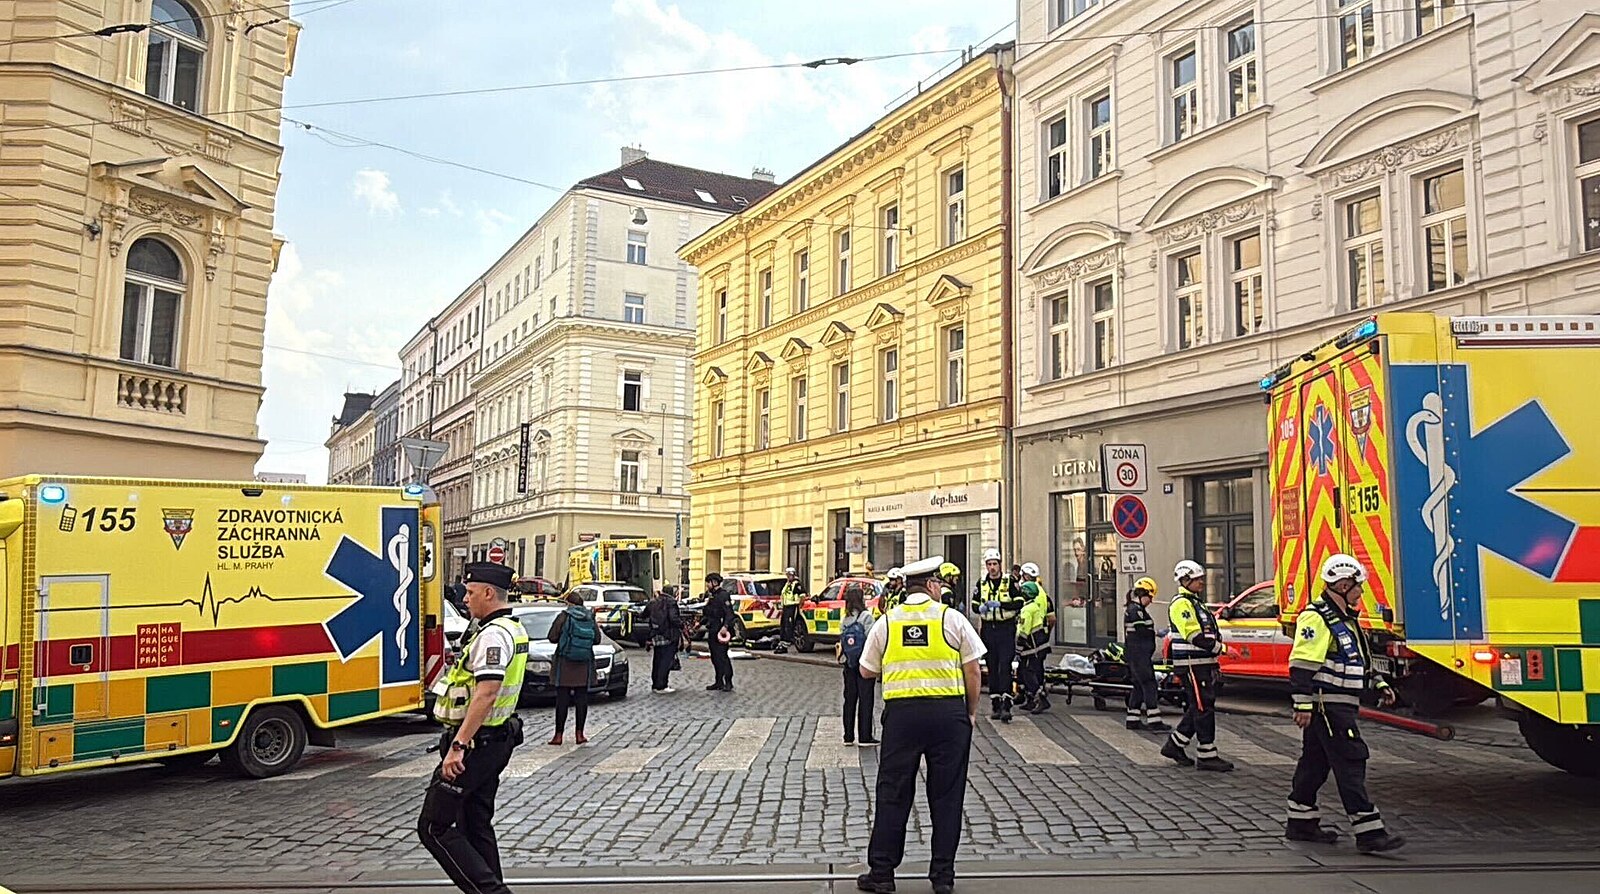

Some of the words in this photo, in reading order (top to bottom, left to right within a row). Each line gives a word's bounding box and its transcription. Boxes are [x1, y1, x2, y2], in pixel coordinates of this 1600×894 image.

[1111, 447, 1140, 459] ZÓNA
[1121, 469, 1134, 481] 30
[1357, 484, 1379, 513] 155
[81, 507, 136, 532] 155
[217, 507, 344, 524] ZDRAVOTNICKÁ
[217, 524, 321, 541] ZÁCHRANNÁ
[217, 542, 285, 559] SLUŽBA
[217, 562, 231, 570] HL.
[233, 562, 242, 570] M.
[245, 562, 274, 570] PRAHY
